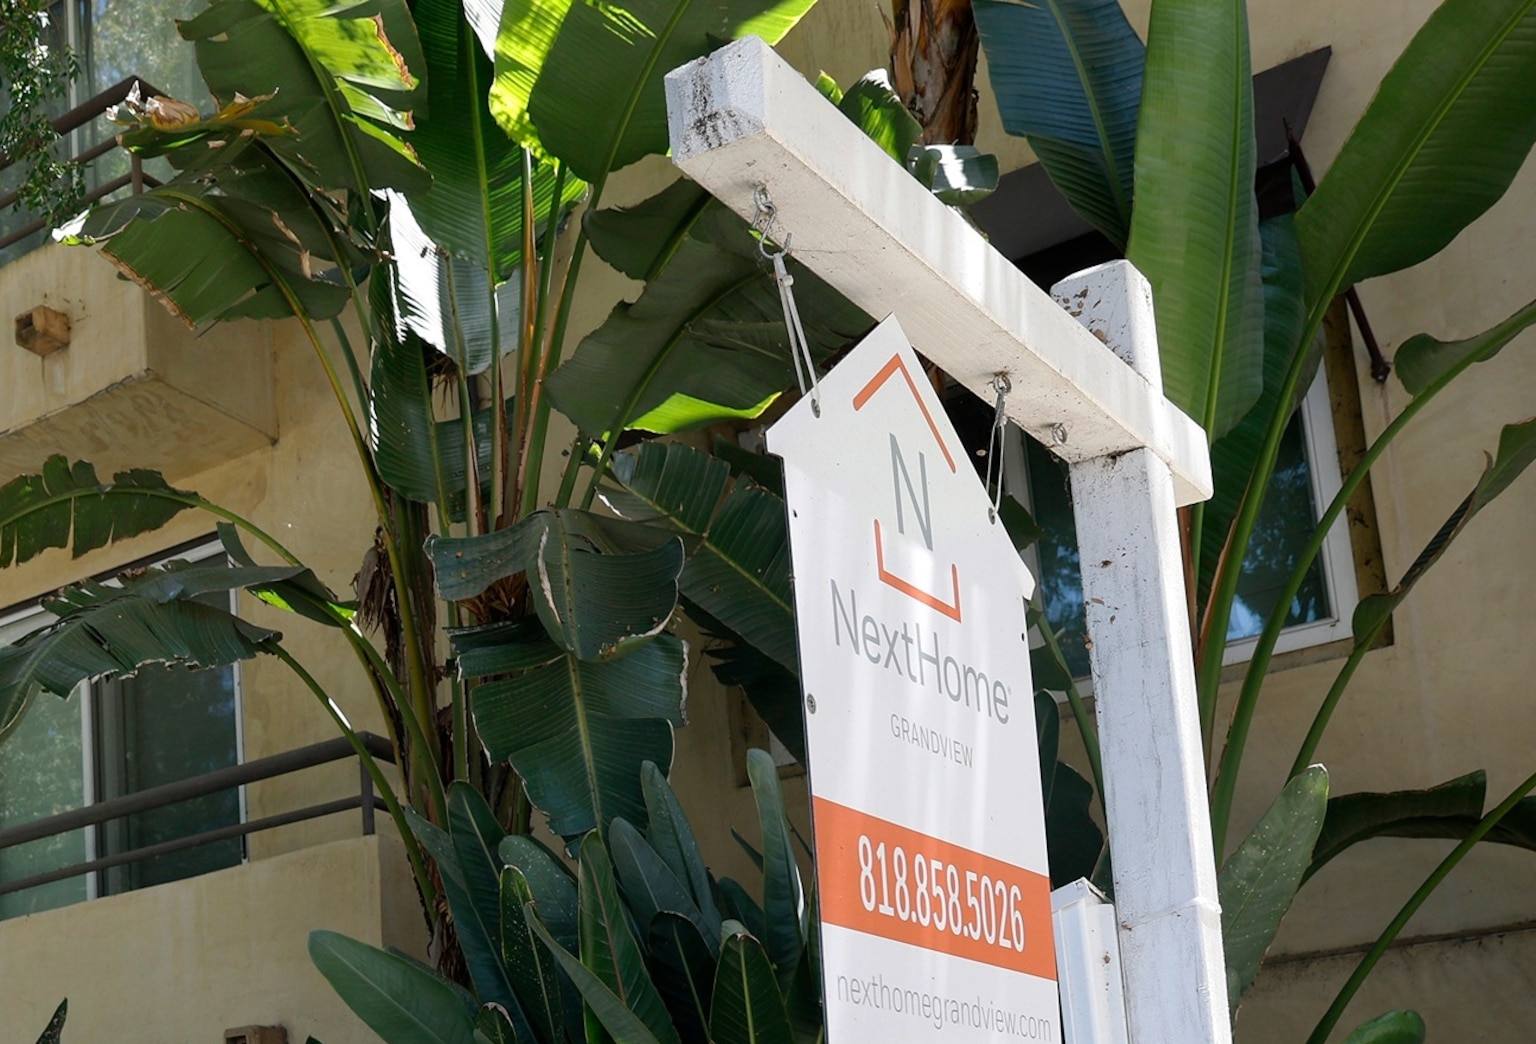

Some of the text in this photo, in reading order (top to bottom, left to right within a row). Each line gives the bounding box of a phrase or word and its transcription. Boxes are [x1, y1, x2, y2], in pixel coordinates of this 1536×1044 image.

[830, 578, 1010, 725] NextHome
[890, 713, 974, 769] GRANDVIEW
[857, 834, 1025, 953] 818.858.5026
[836, 973, 1052, 1042] nexthomegrandview.com
